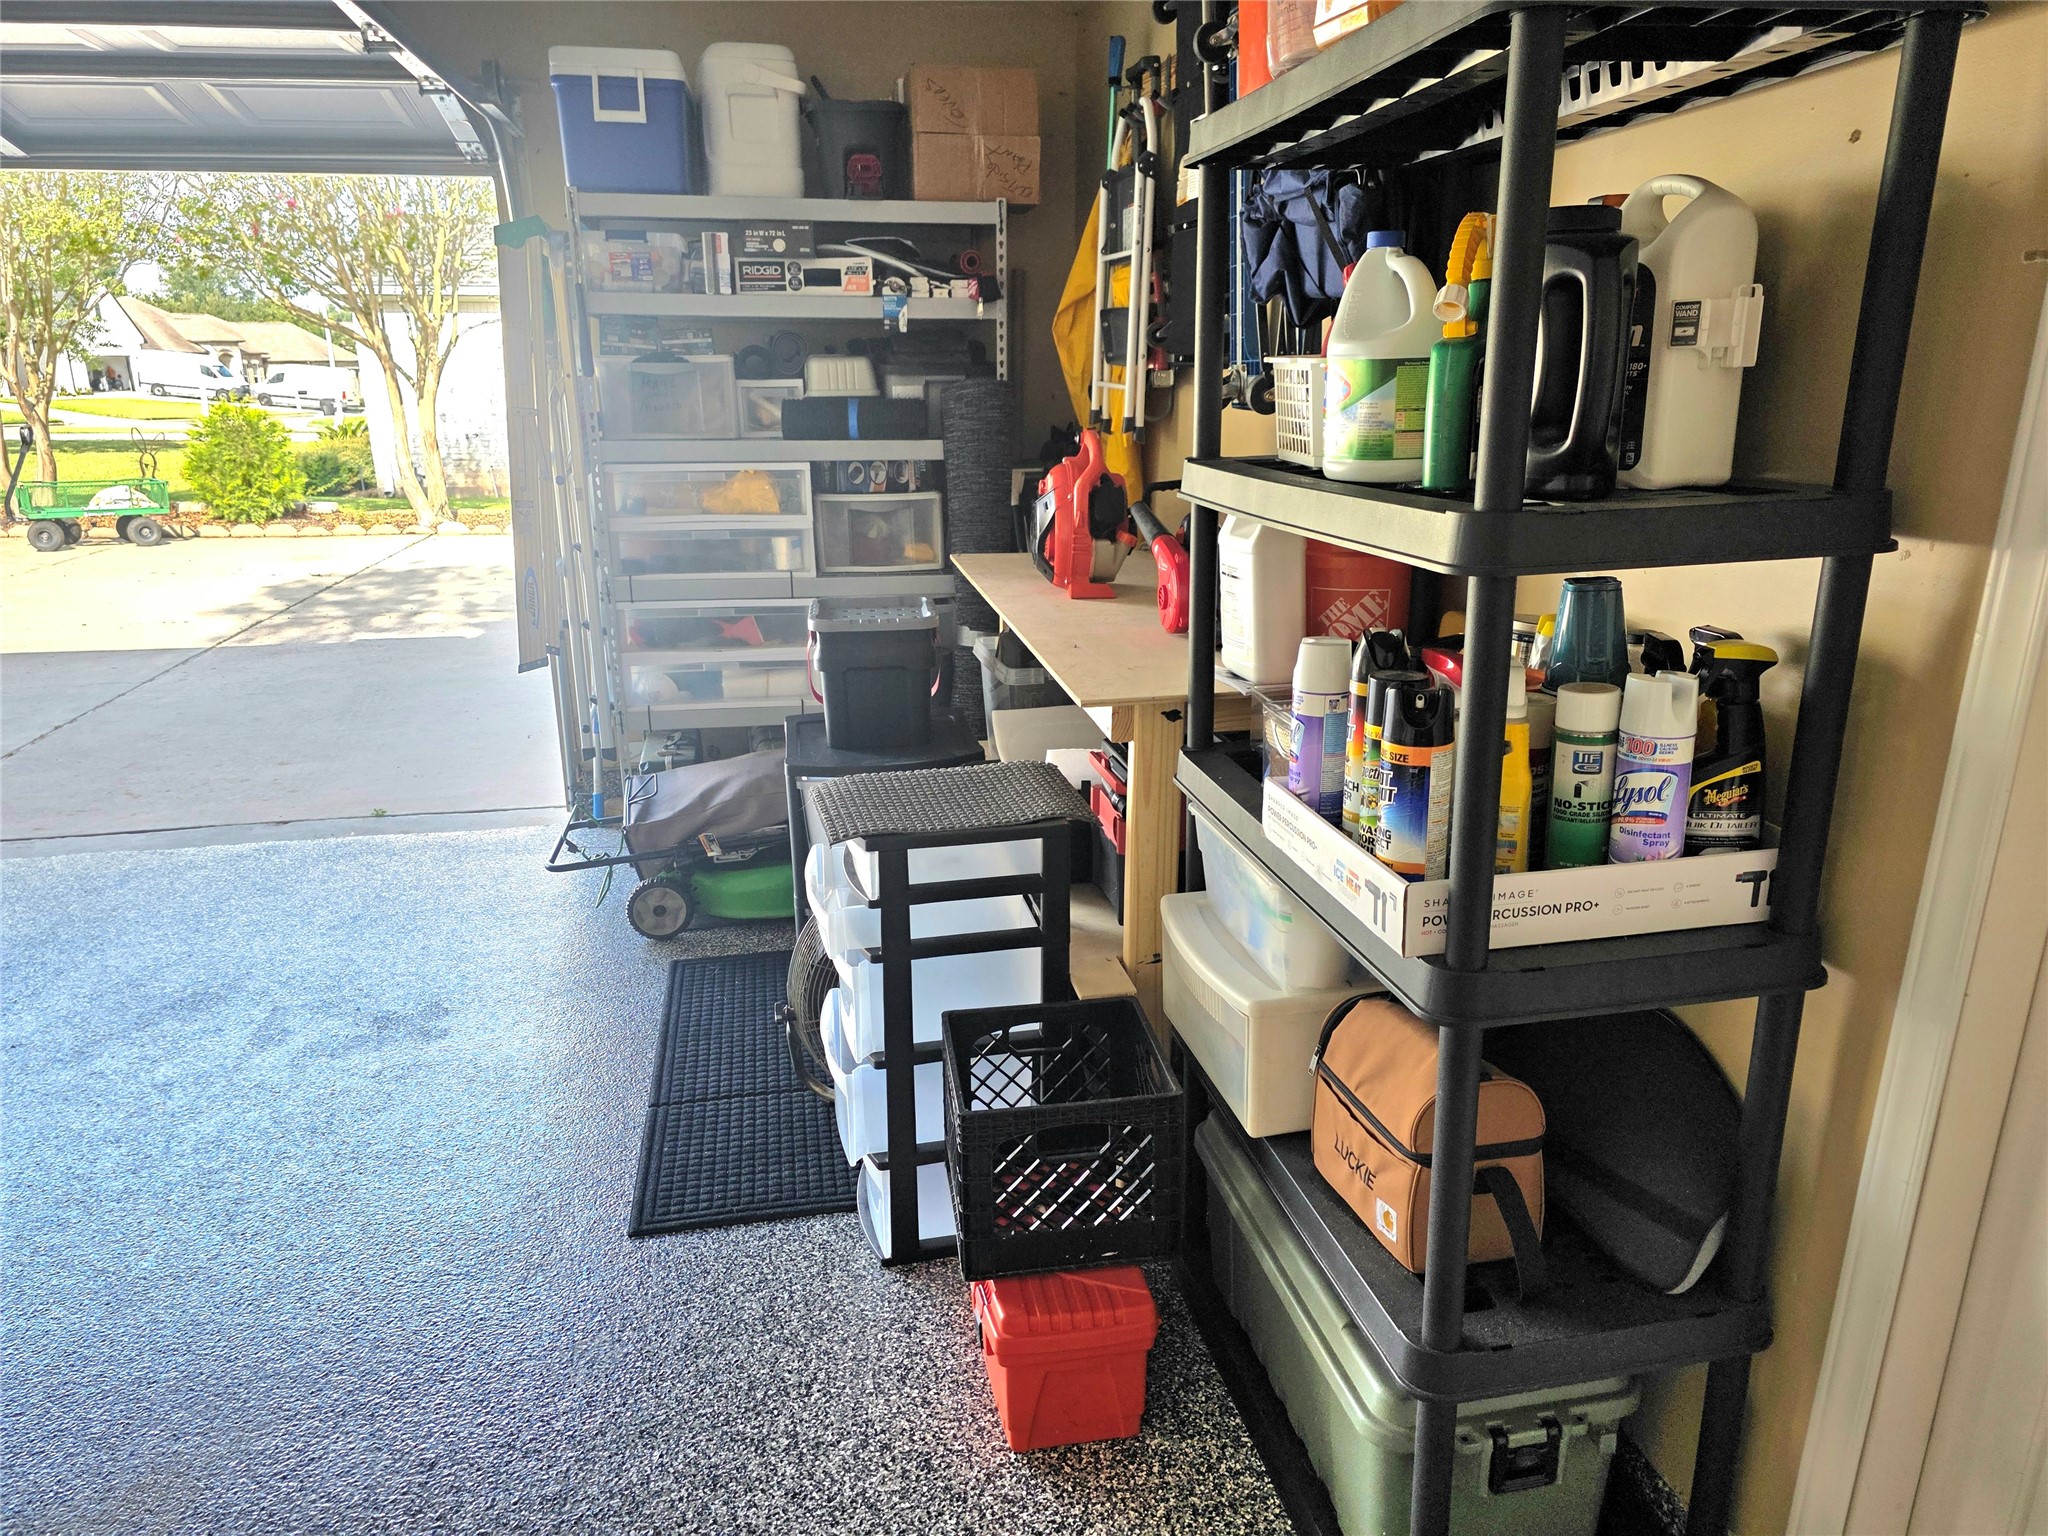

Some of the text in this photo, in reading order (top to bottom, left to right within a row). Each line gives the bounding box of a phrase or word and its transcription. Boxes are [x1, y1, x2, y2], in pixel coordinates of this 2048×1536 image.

[742, 265, 781, 275] RIDGID
[1675, 309, 1698, 317] WAND
[1629, 362, 1647, 371] 180+
[1317, 597, 1351, 628] THE
[1626, 736, 1655, 757] 100
[1389, 751, 1409, 763] SIZE
[1613, 775, 1671, 816] Lysol
[1569, 810, 1591, 818] GRADE
[1710, 821, 1757, 829] DETAILER
[1619, 826, 1671, 839] Disinfectant
[1642, 838, 1670, 848] Spray
[1333, 864, 1362, 897] ICE HEAT
[1493, 889, 1534, 901] IMAGE
[1493, 900, 1600, 921] RCUSSION PRO+
[1334, 1130, 1377, 1192] LUCKIE
